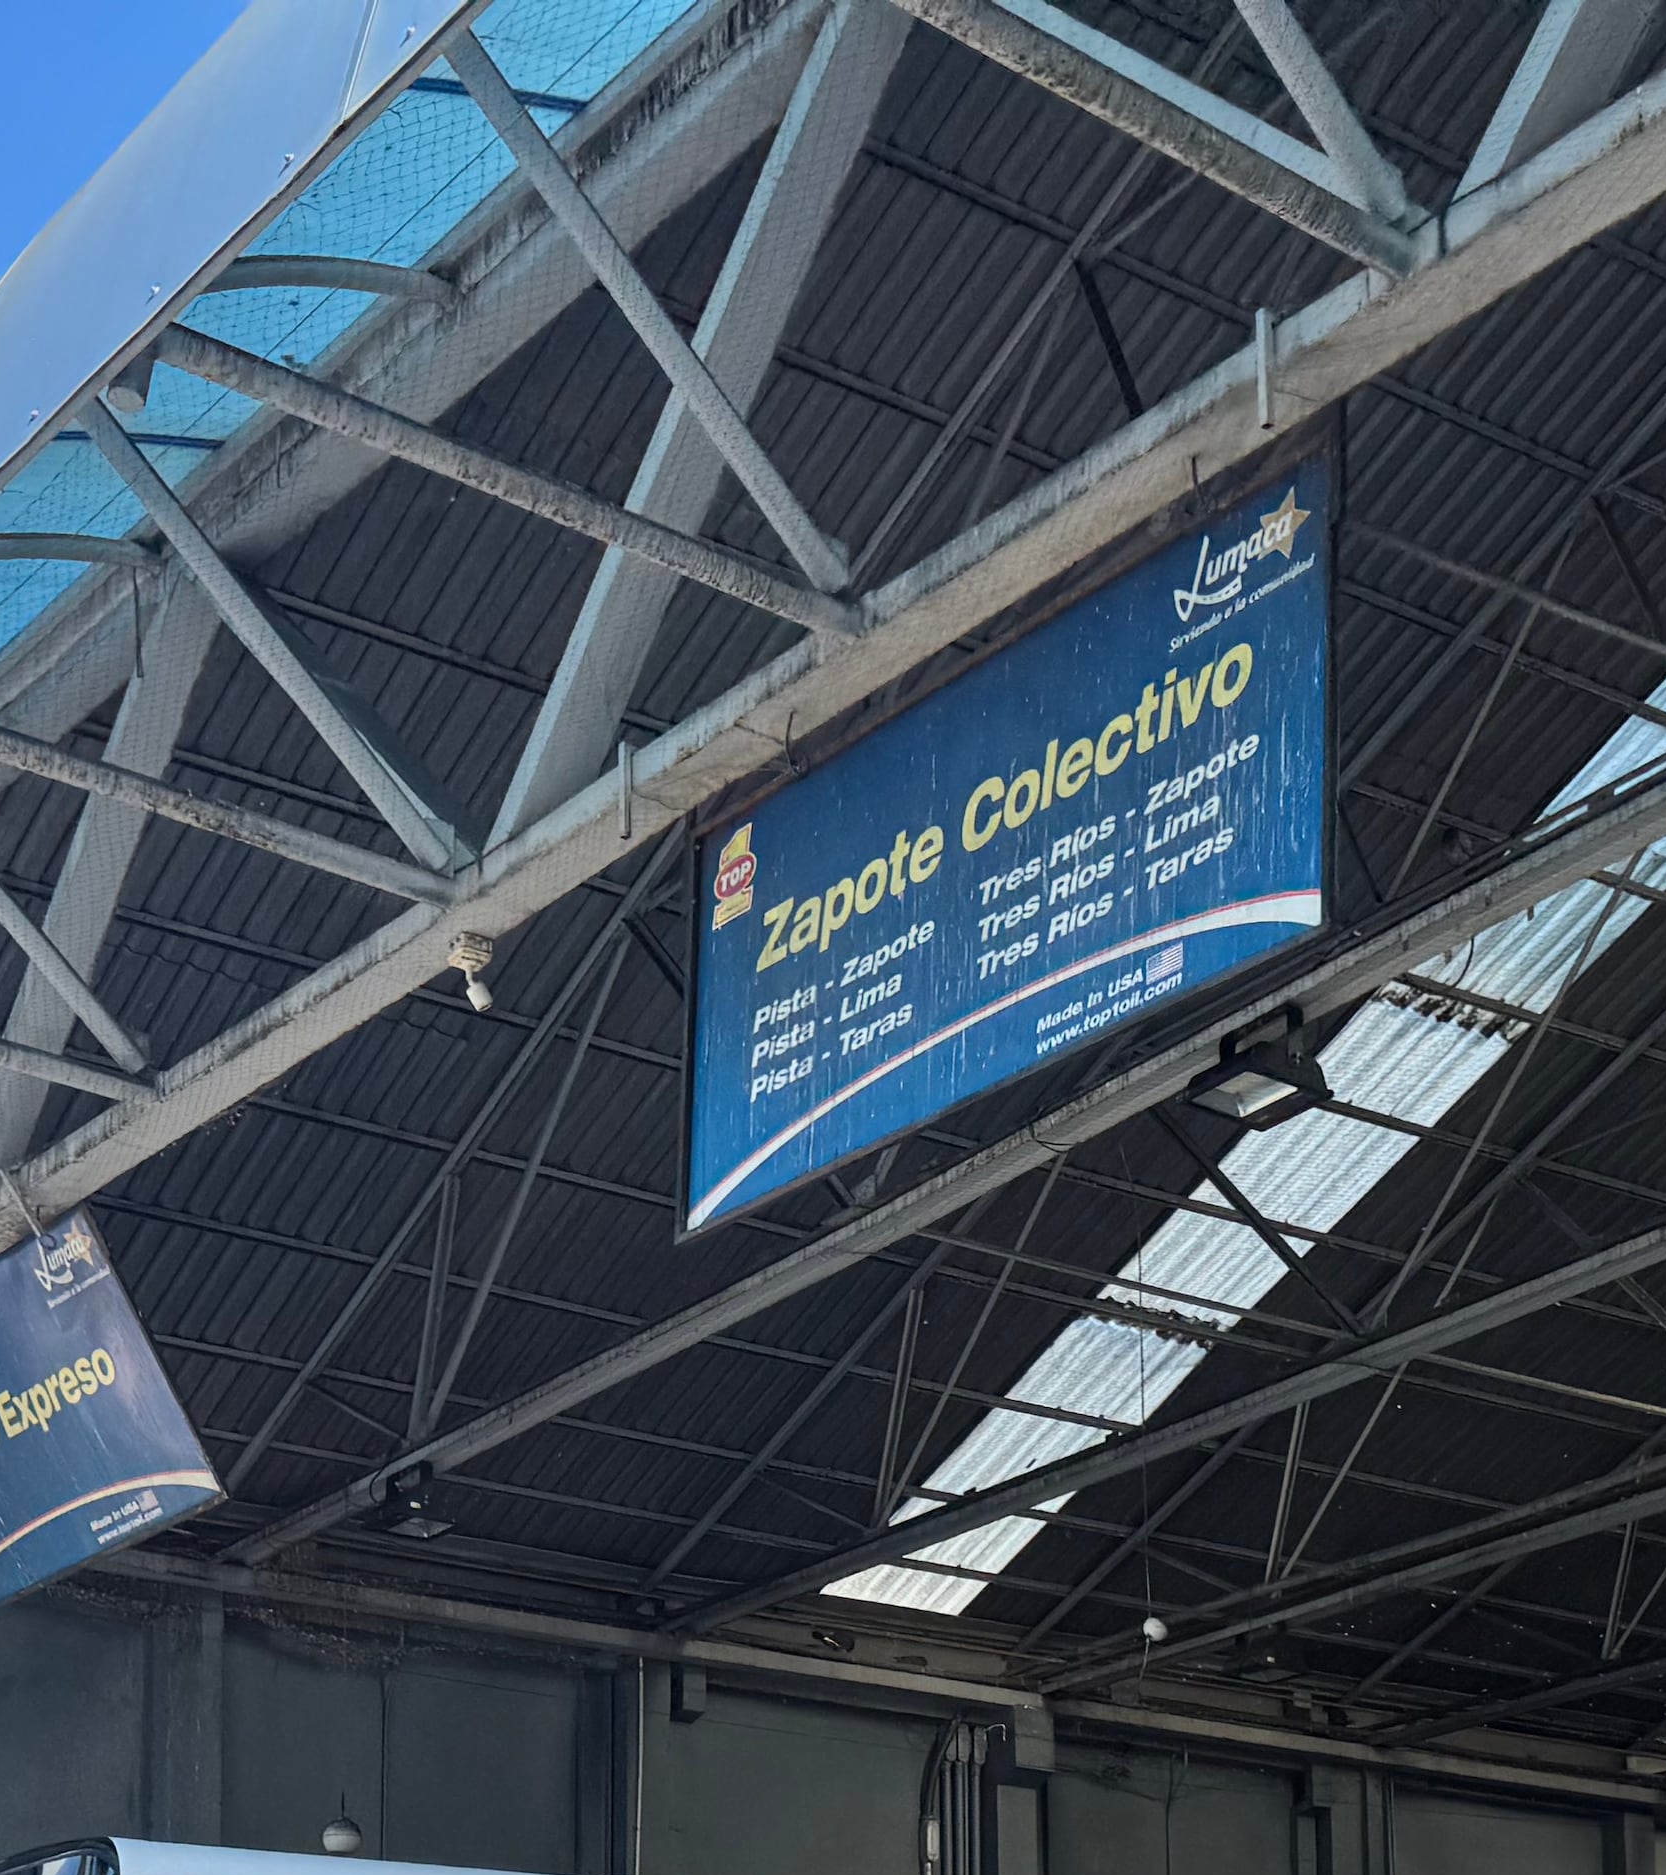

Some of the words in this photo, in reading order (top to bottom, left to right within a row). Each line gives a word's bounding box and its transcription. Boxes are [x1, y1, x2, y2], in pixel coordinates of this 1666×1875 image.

[1174, 511, 1294, 622] Lumaca
[756, 825, 945, 973] Zapote
[961, 643, 1253, 852] Colectivo
[979, 856, 1042, 905] Tres
[1049, 814, 1117, 869] Ríos
[1144, 734, 1260, 815] Zapote
[720, 860, 753, 893] TOP
[976, 932, 1039, 981] Tres
[1046, 891, 1114, 945] Ríos
[1145, 827, 1235, 890] Taras
[978, 894, 1041, 943] Tres
[1048, 853, 1115, 907] Ríos
[1144, 795, 1221, 854] Lima
[751, 1019, 815, 1069] Pista
[839, 973, 902, 1022] Lima
[753, 984, 818, 1034] Pista
[840, 920, 935, 987] Zapote
[1036, 1001, 1083, 1035] Made
[1108, 967, 1144, 998] USA
[1036, 972, 1183, 1055] www.top1oil.com
[750, 1055, 814, 1104] Pista
[839, 1003, 913, 1056] Taras
